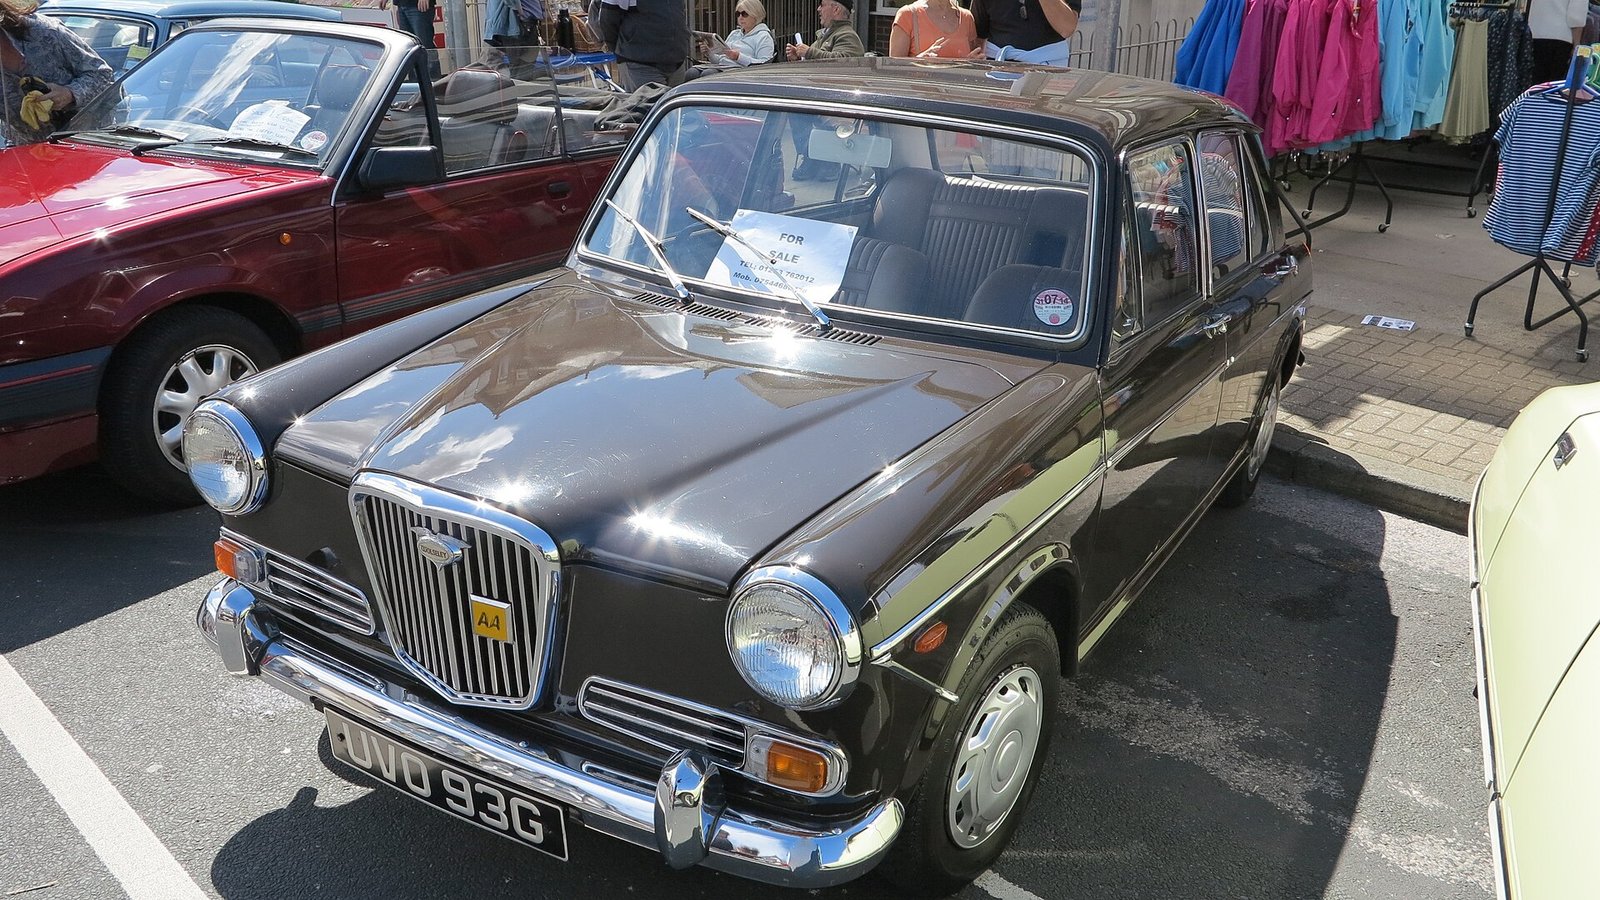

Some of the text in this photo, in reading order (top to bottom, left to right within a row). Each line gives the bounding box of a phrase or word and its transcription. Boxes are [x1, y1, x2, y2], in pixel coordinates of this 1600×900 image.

[779, 233, 805, 246] FOR
[768, 250, 801, 264] SALE
[733, 272, 752, 283] Mob.
[785, 270, 816, 284] 762012
[1044, 294, 1058, 304] 07
[477, 611, 500, 631] AA
[341, 721, 544, 845] UVO 93G
